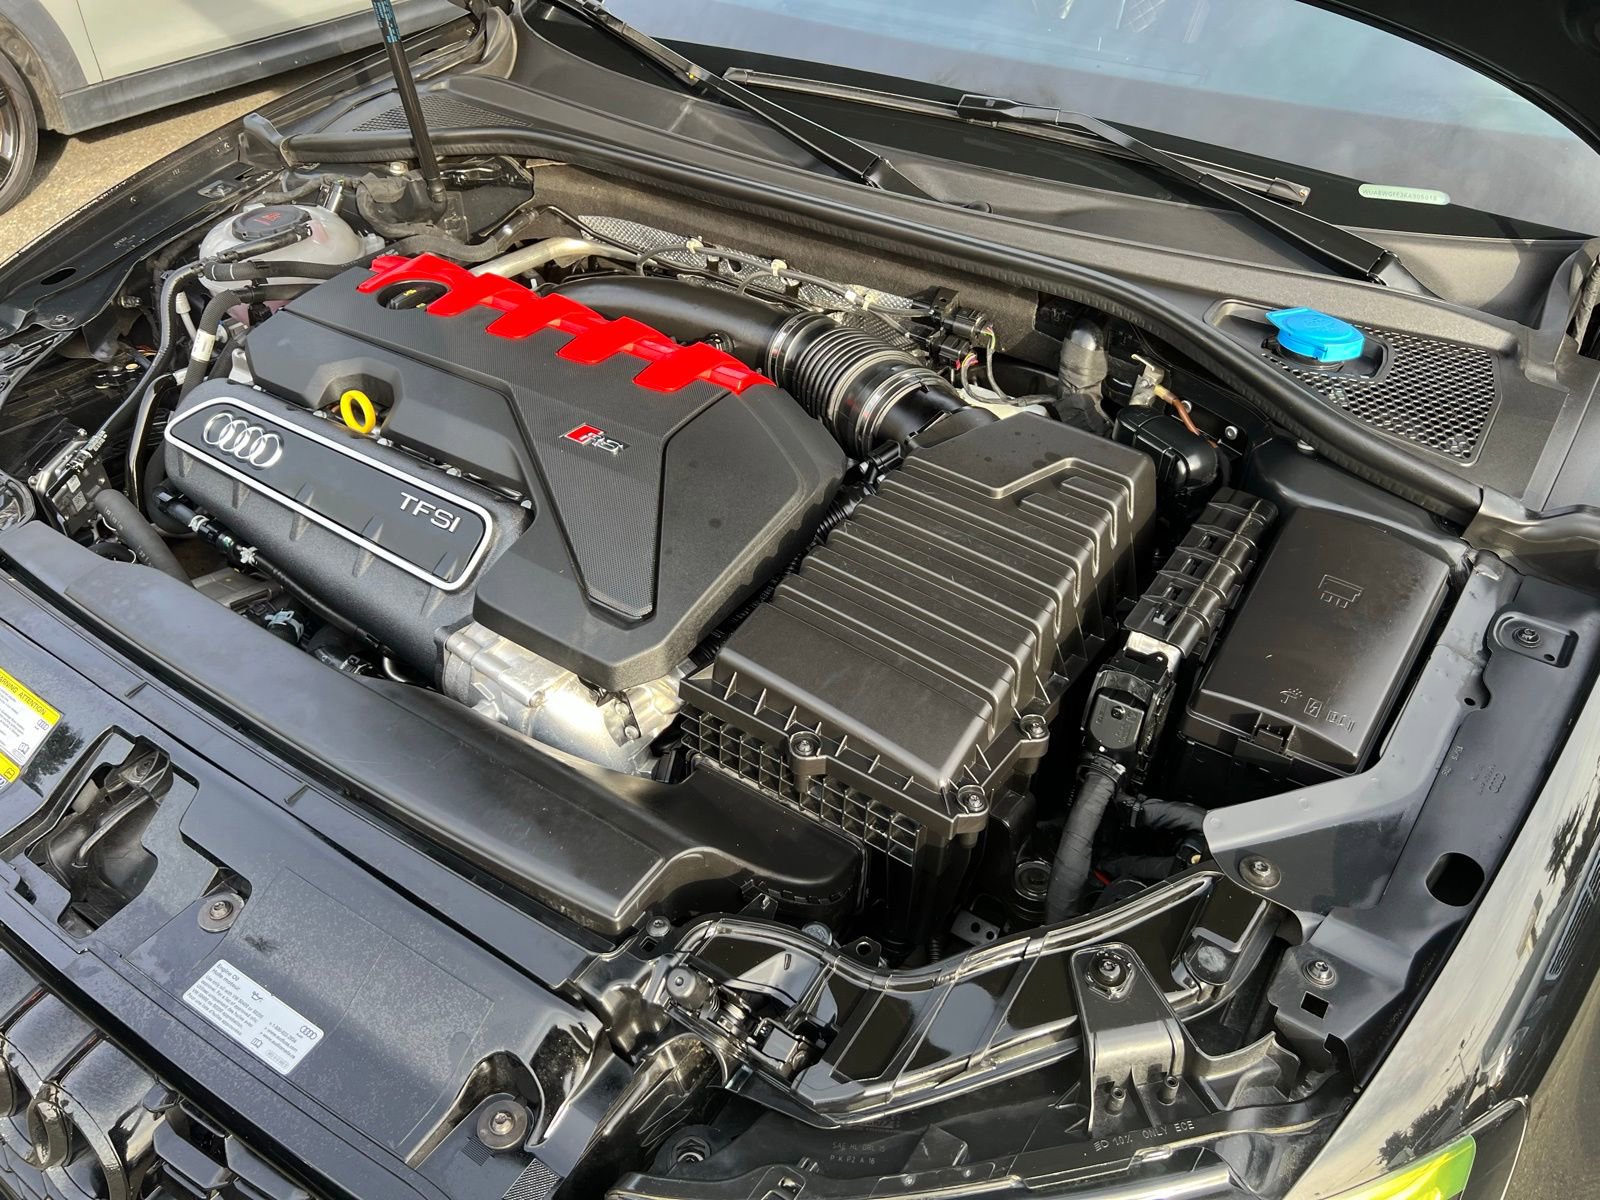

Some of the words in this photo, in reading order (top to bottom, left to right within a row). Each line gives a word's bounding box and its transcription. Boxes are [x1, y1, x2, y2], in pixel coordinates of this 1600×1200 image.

[400, 492, 460, 532] TFSI
[0, 675, 18, 693] ARNING
[19, 692, 46, 715] ATTENTION
[215, 963, 233, 976] Engine
[222, 976, 240, 991] moteur
[1142, 1125, 1168, 1139] ONLY
[1173, 1120, 1195, 1132] ECE
